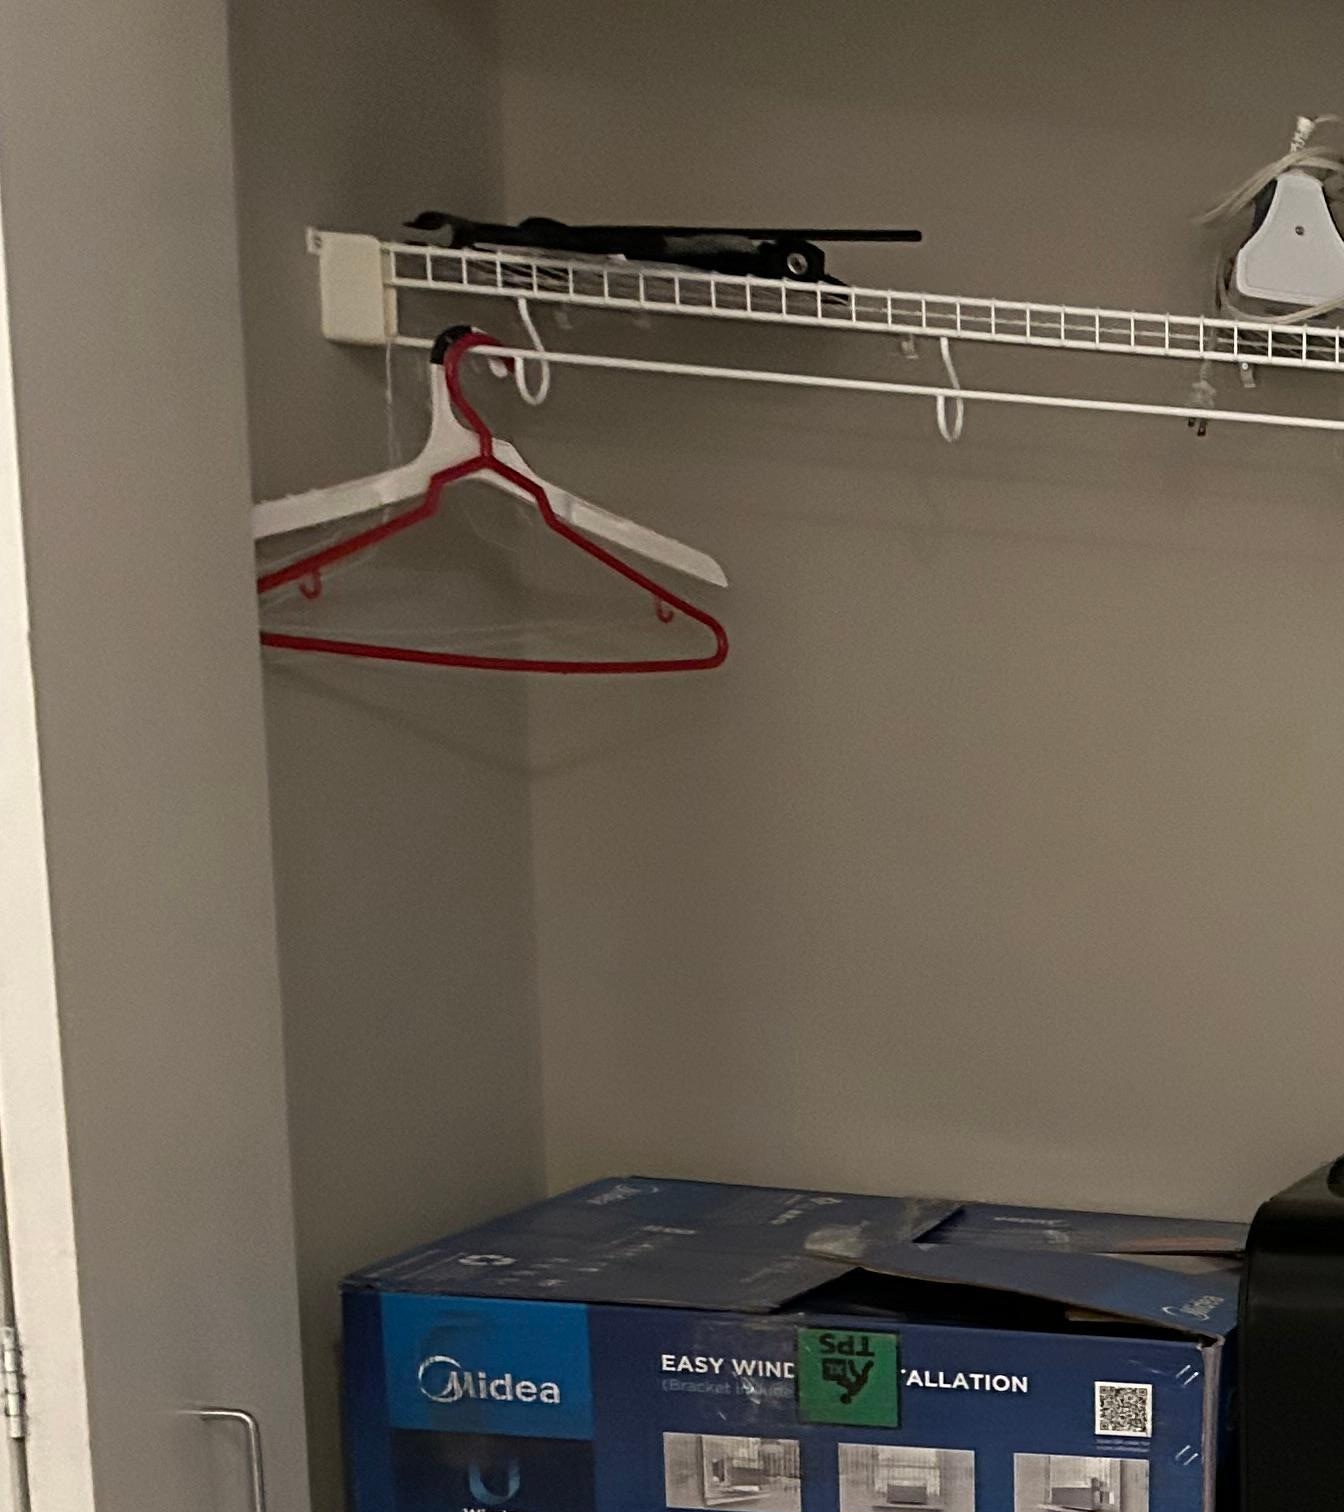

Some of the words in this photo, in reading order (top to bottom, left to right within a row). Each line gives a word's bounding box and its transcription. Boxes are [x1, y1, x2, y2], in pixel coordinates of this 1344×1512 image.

[819, 1333, 876, 1357] TPS
[418, 1355, 562, 1405] Midea
[661, 1354, 724, 1375] EASY
[732, 1357, 795, 1379] WIND
[901, 1367, 1029, 1394] ALLATION
